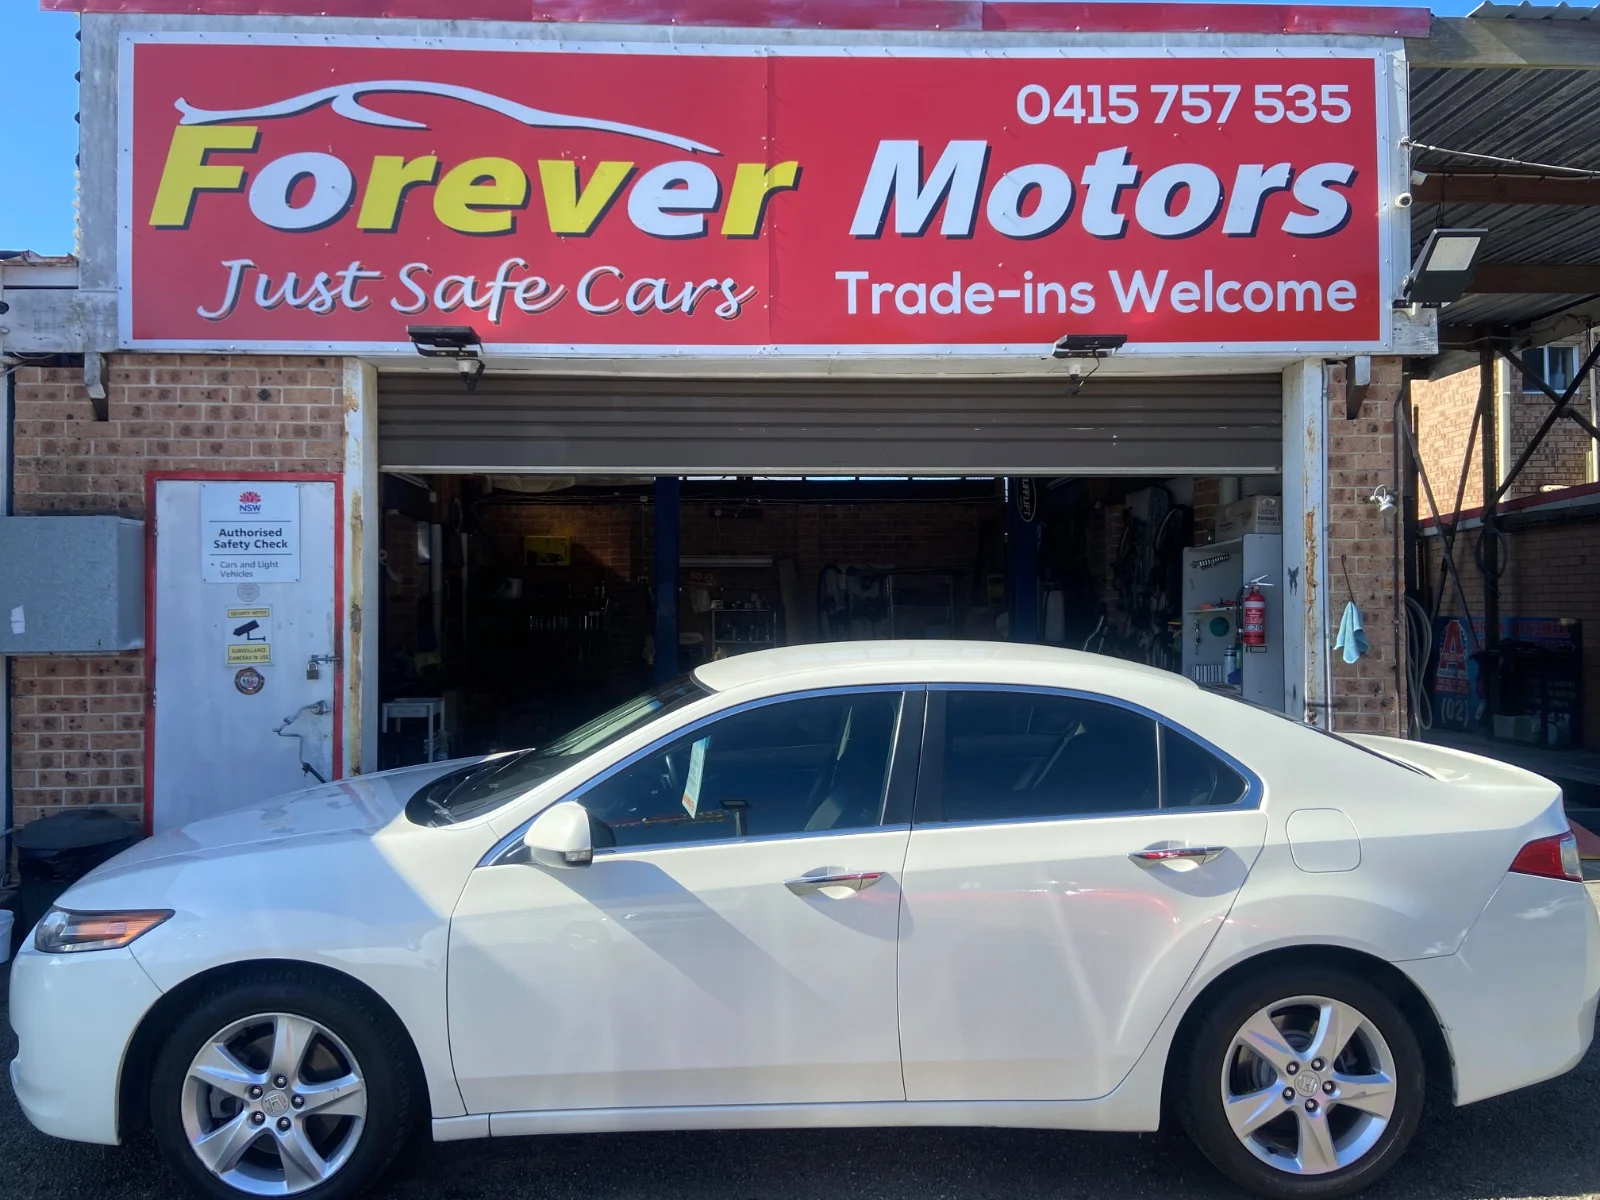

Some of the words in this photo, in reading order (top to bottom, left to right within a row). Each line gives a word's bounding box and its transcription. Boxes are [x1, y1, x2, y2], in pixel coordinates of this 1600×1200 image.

[1017, 84, 1138, 125] 0415
[1151, 84, 1241, 124] 757
[1255, 83, 1352, 124] 535
[149, 125, 800, 238] Forever
[849, 139, 1357, 239] Motors
[196, 258, 381, 319] Just
[390, 257, 566, 323] Safe
[576, 265, 756, 320] Cars
[835, 270, 1096, 315] Trade-ins
[1109, 270, 1357, 314] Welcome
[239, 504, 261, 512] NSW
[213, 539, 250, 550] Safety
[254, 539, 288, 549] Check
[218, 528, 282, 537] Authorised
[257, 560, 279, 569] Light
[1441, 697, 1468, 727] (02)
